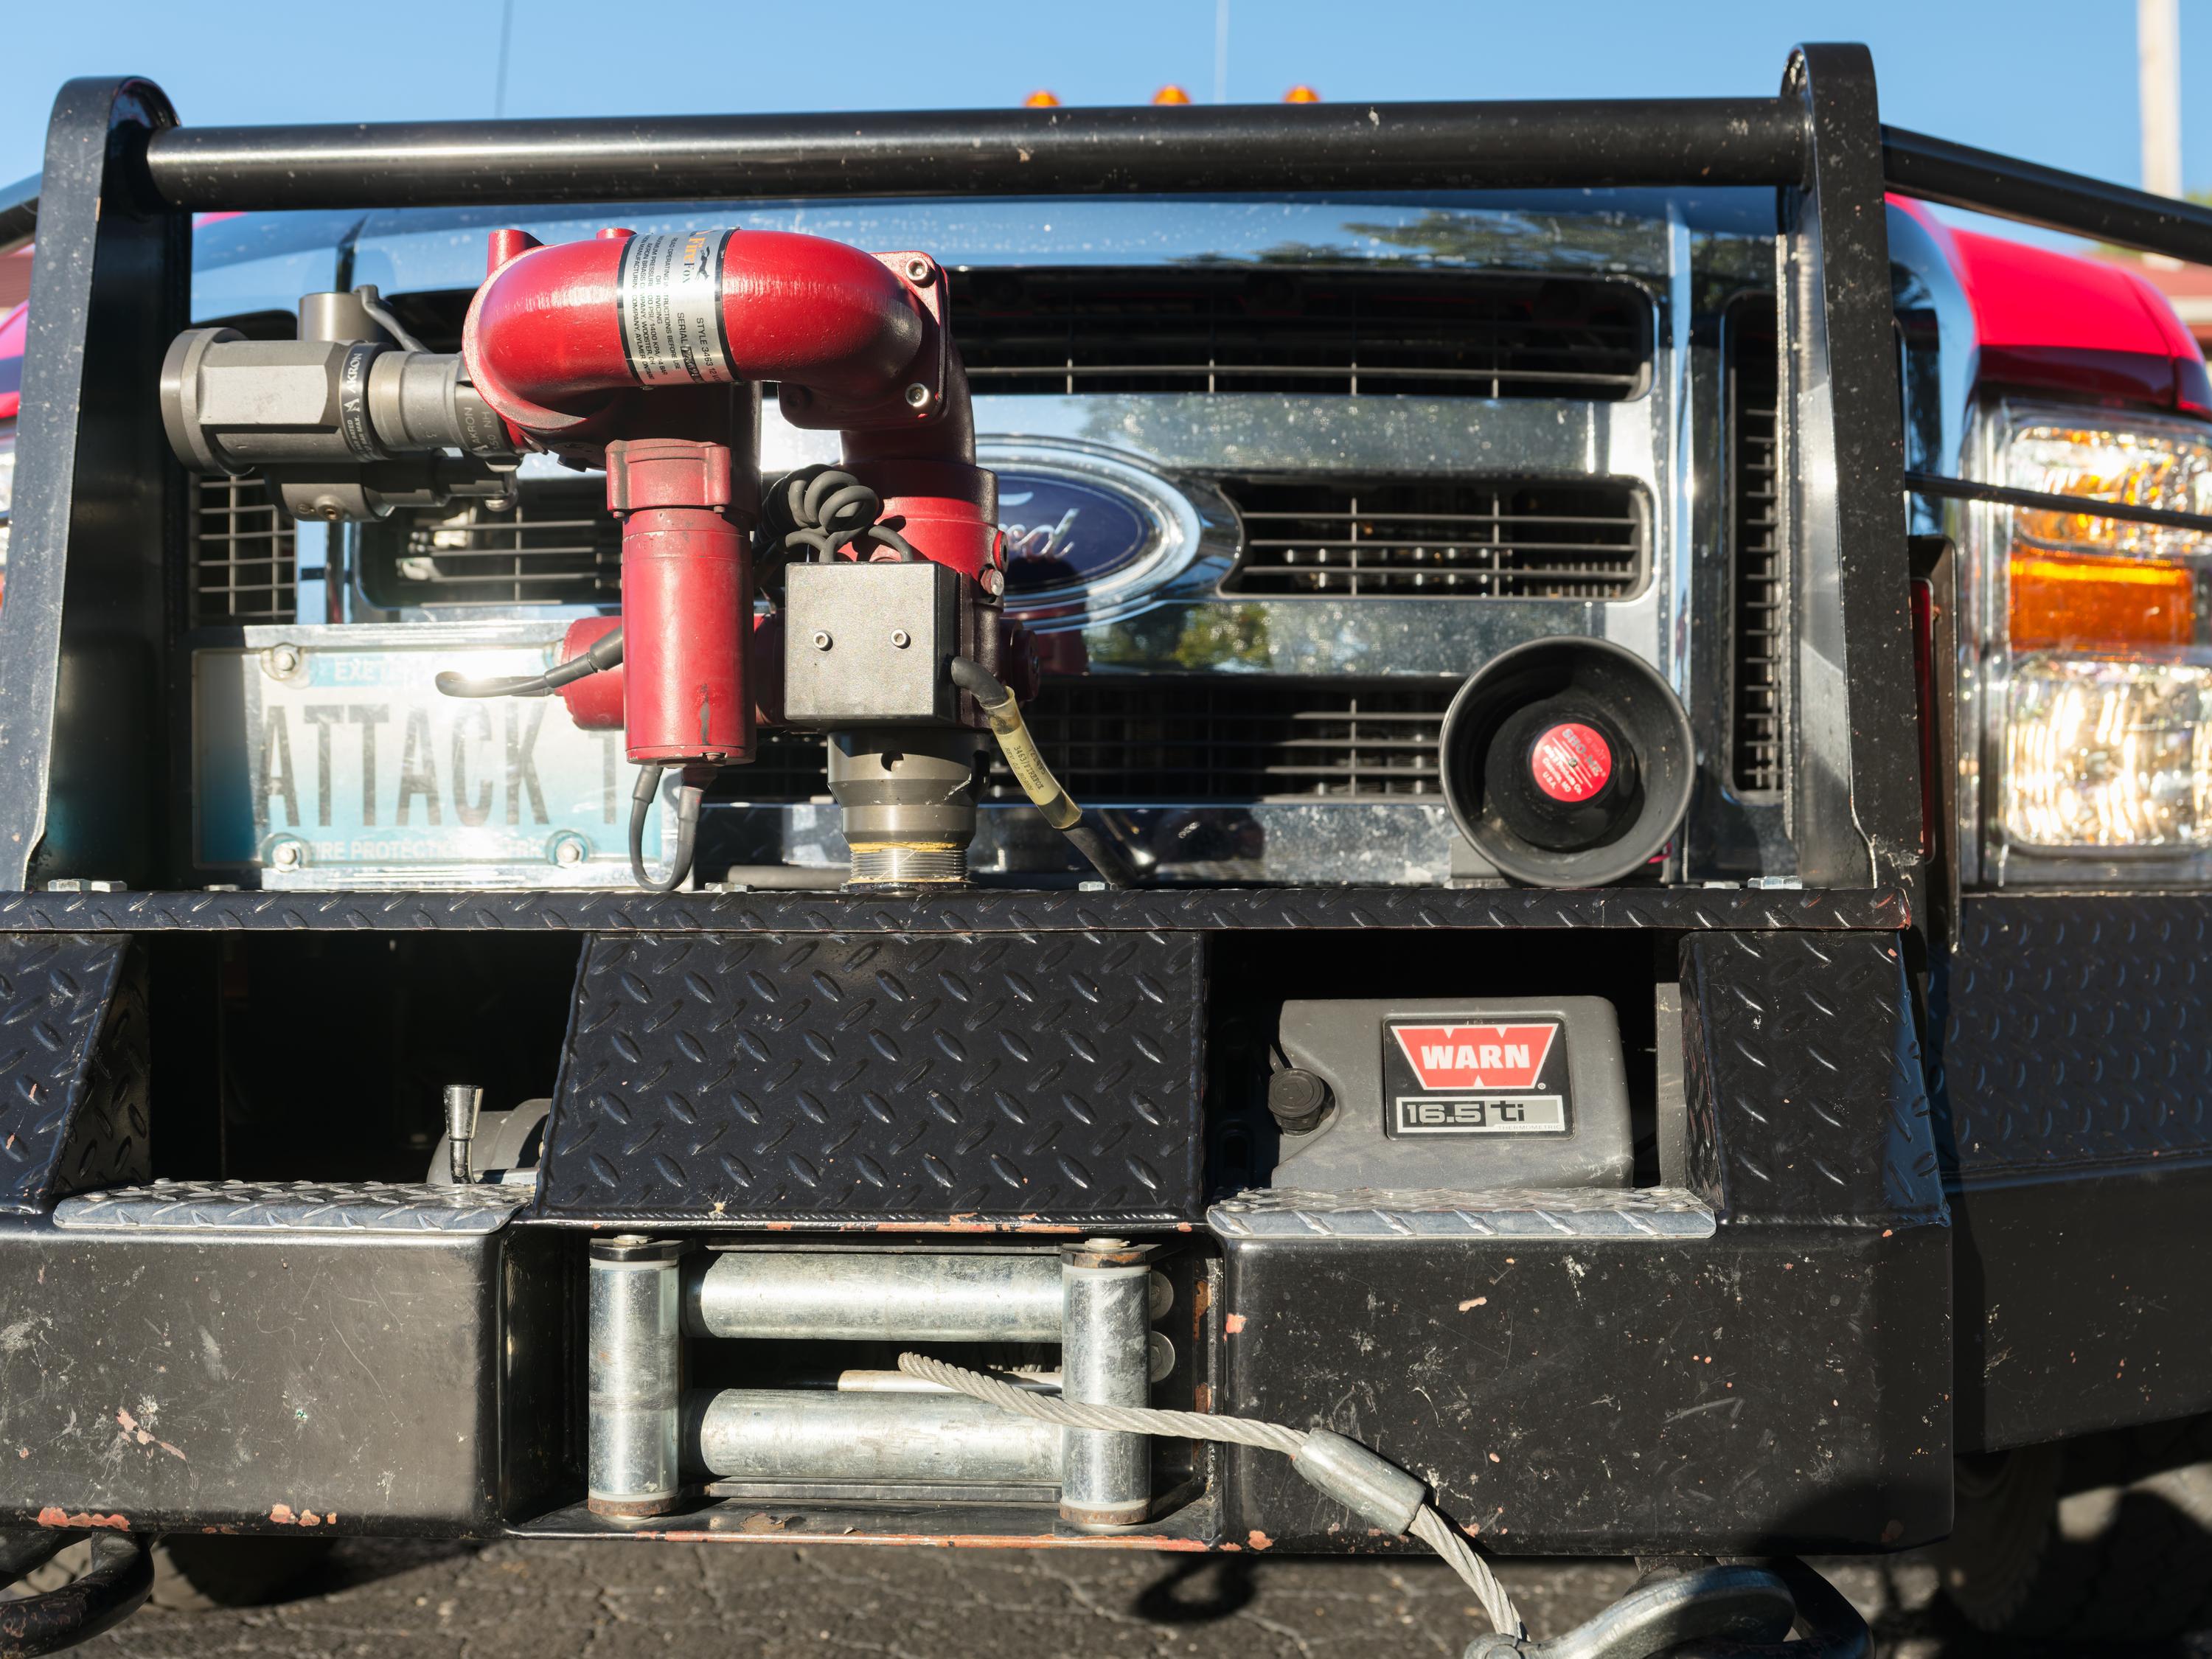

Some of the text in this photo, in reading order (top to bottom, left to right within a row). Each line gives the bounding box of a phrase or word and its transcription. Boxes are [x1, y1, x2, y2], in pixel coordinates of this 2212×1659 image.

[640, 260, 648, 282] BRASS
[664, 248, 674, 281] OPERATING
[678, 313, 689, 344] SERIAL
[697, 318, 709, 345] STYLE
[667, 335, 678, 359] BEFORE
[701, 347, 714, 366] 3463
[347, 353, 363, 394] AKRON
[672, 359, 681, 370] USE
[347, 419, 357, 440] RATED
[464, 407, 481, 444] AKRON
[481, 411, 493, 428] NH
[254, 701, 550, 827] ATTACK
[1013, 745, 1044, 790] 3463/FIREFOX
[1421, 1044, 1531, 1070] WARN
[1407, 1101, 1525, 1124] 16.5 ti
